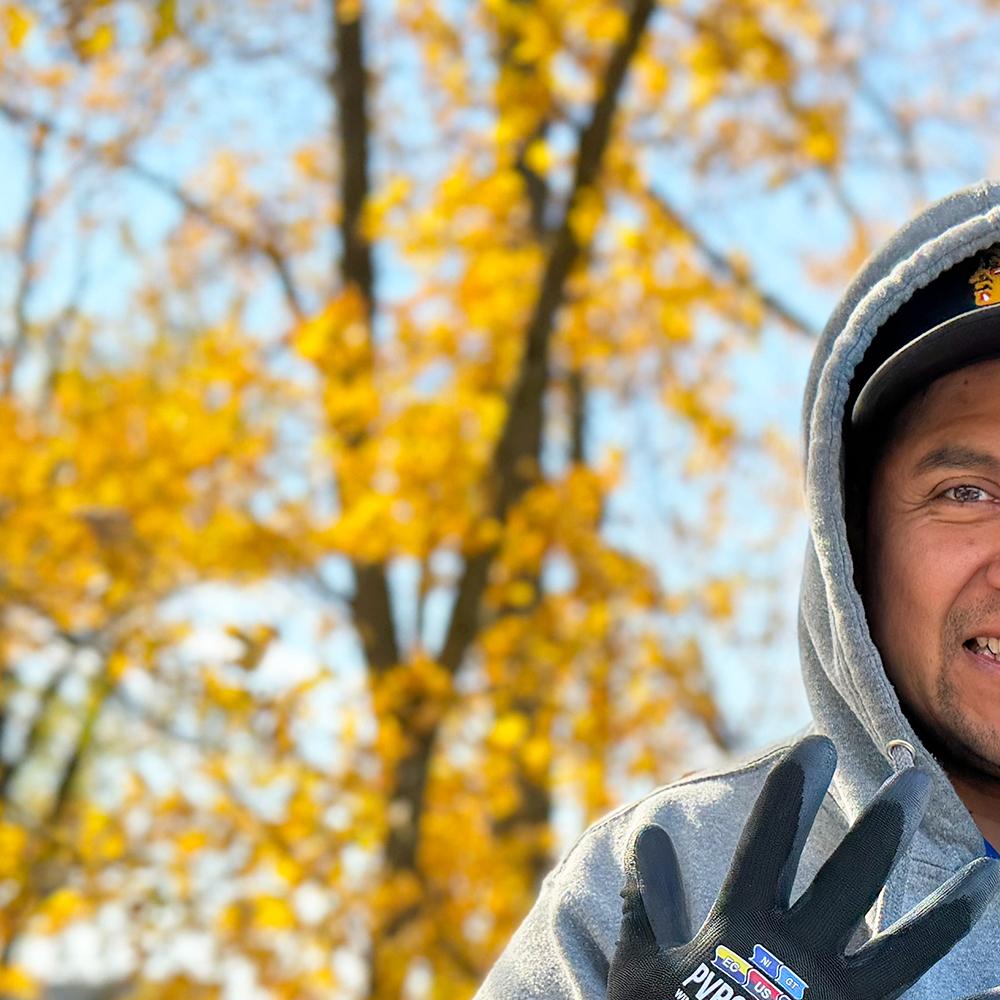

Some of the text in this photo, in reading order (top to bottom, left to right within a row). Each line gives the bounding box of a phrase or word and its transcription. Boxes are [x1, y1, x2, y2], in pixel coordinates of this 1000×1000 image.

[723, 958, 740, 973] EC
[754, 982, 771, 999] US
[760, 956, 798, 990] NI GT
